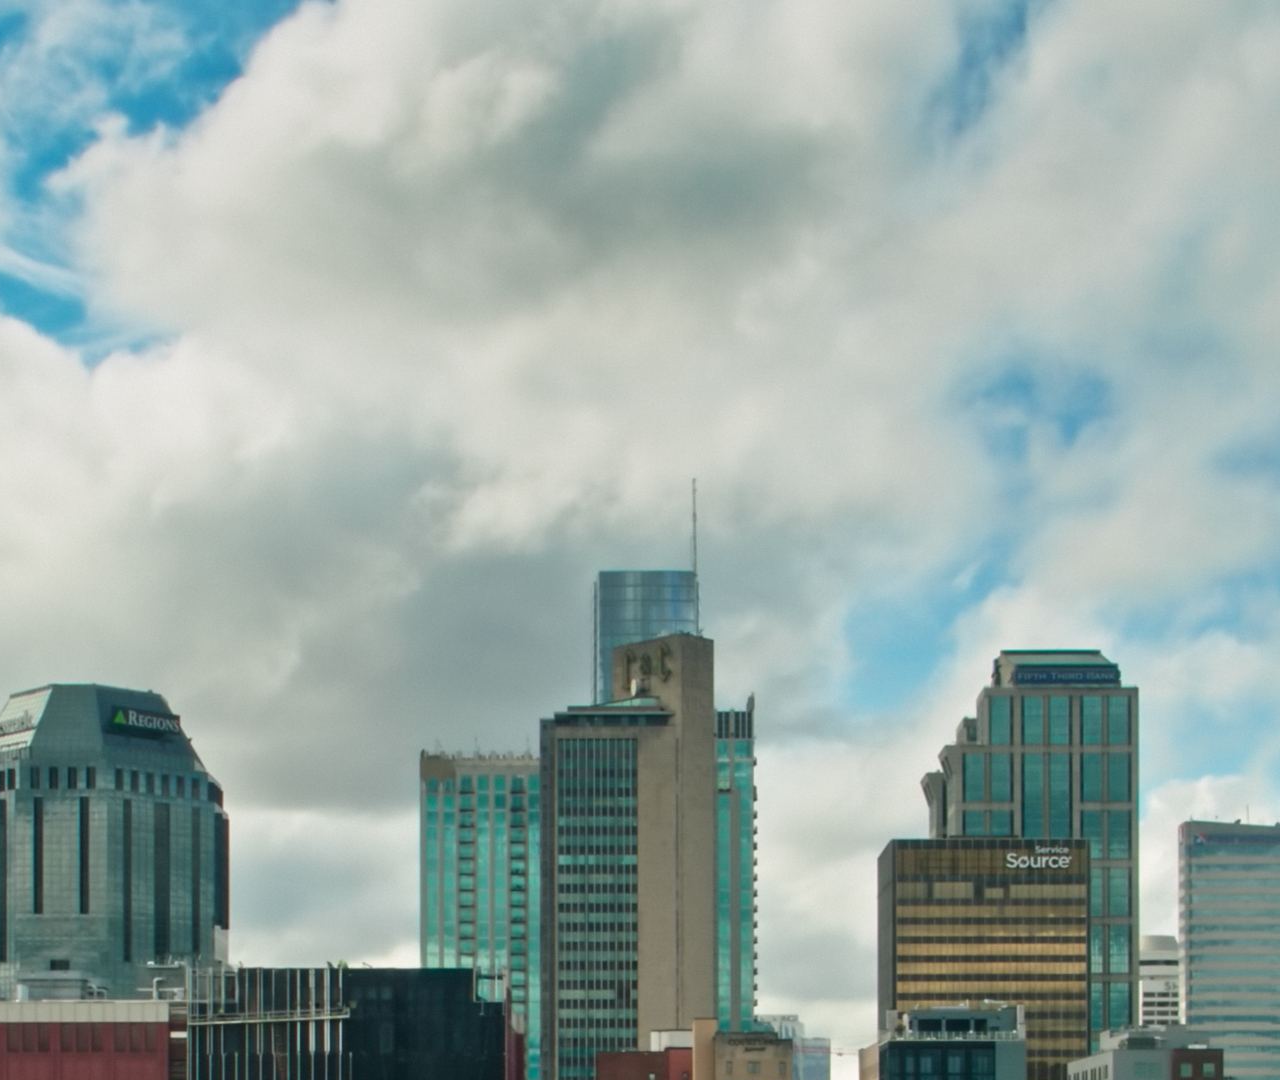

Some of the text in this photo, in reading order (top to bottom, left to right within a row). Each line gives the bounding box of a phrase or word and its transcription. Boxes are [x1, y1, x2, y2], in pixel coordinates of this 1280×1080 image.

[1017, 672, 1116, 680] FIFTH THIRD BANK
[128, 710, 179, 732] REGIONS
[1035, 846, 1069, 854] Service
[1006, 853, 1070, 868] Source
